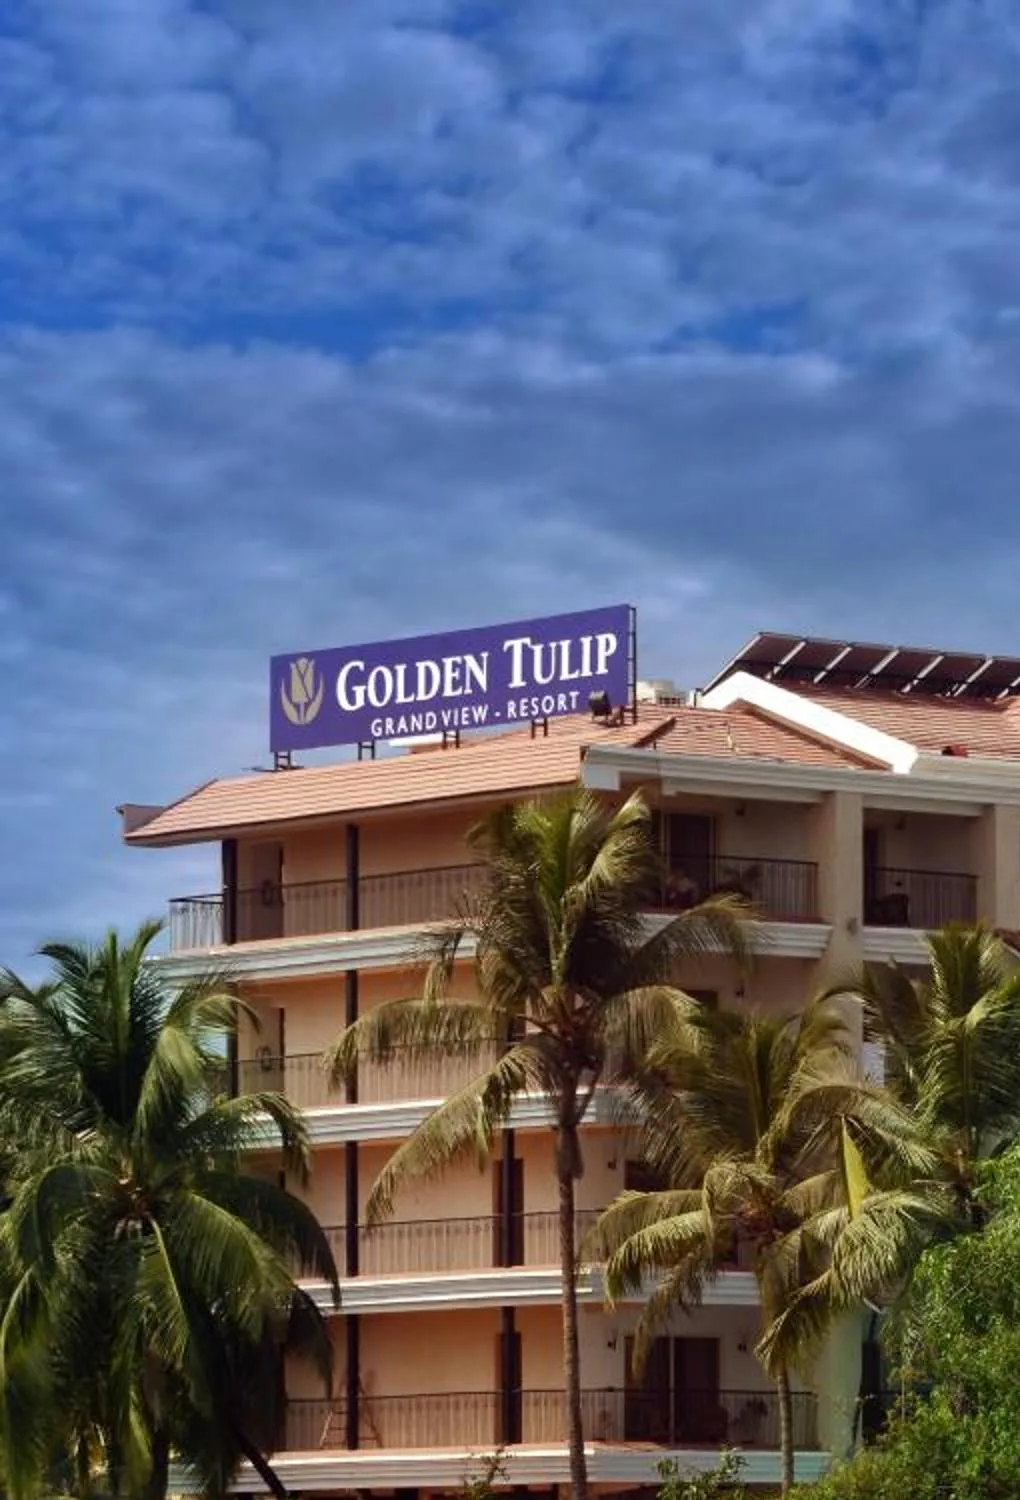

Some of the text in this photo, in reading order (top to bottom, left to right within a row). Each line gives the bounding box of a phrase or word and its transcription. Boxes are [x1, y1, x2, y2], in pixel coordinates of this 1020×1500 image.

[336, 632, 617, 712] GOLDEN TULIP
[507, 691, 580, 719] RESORT
